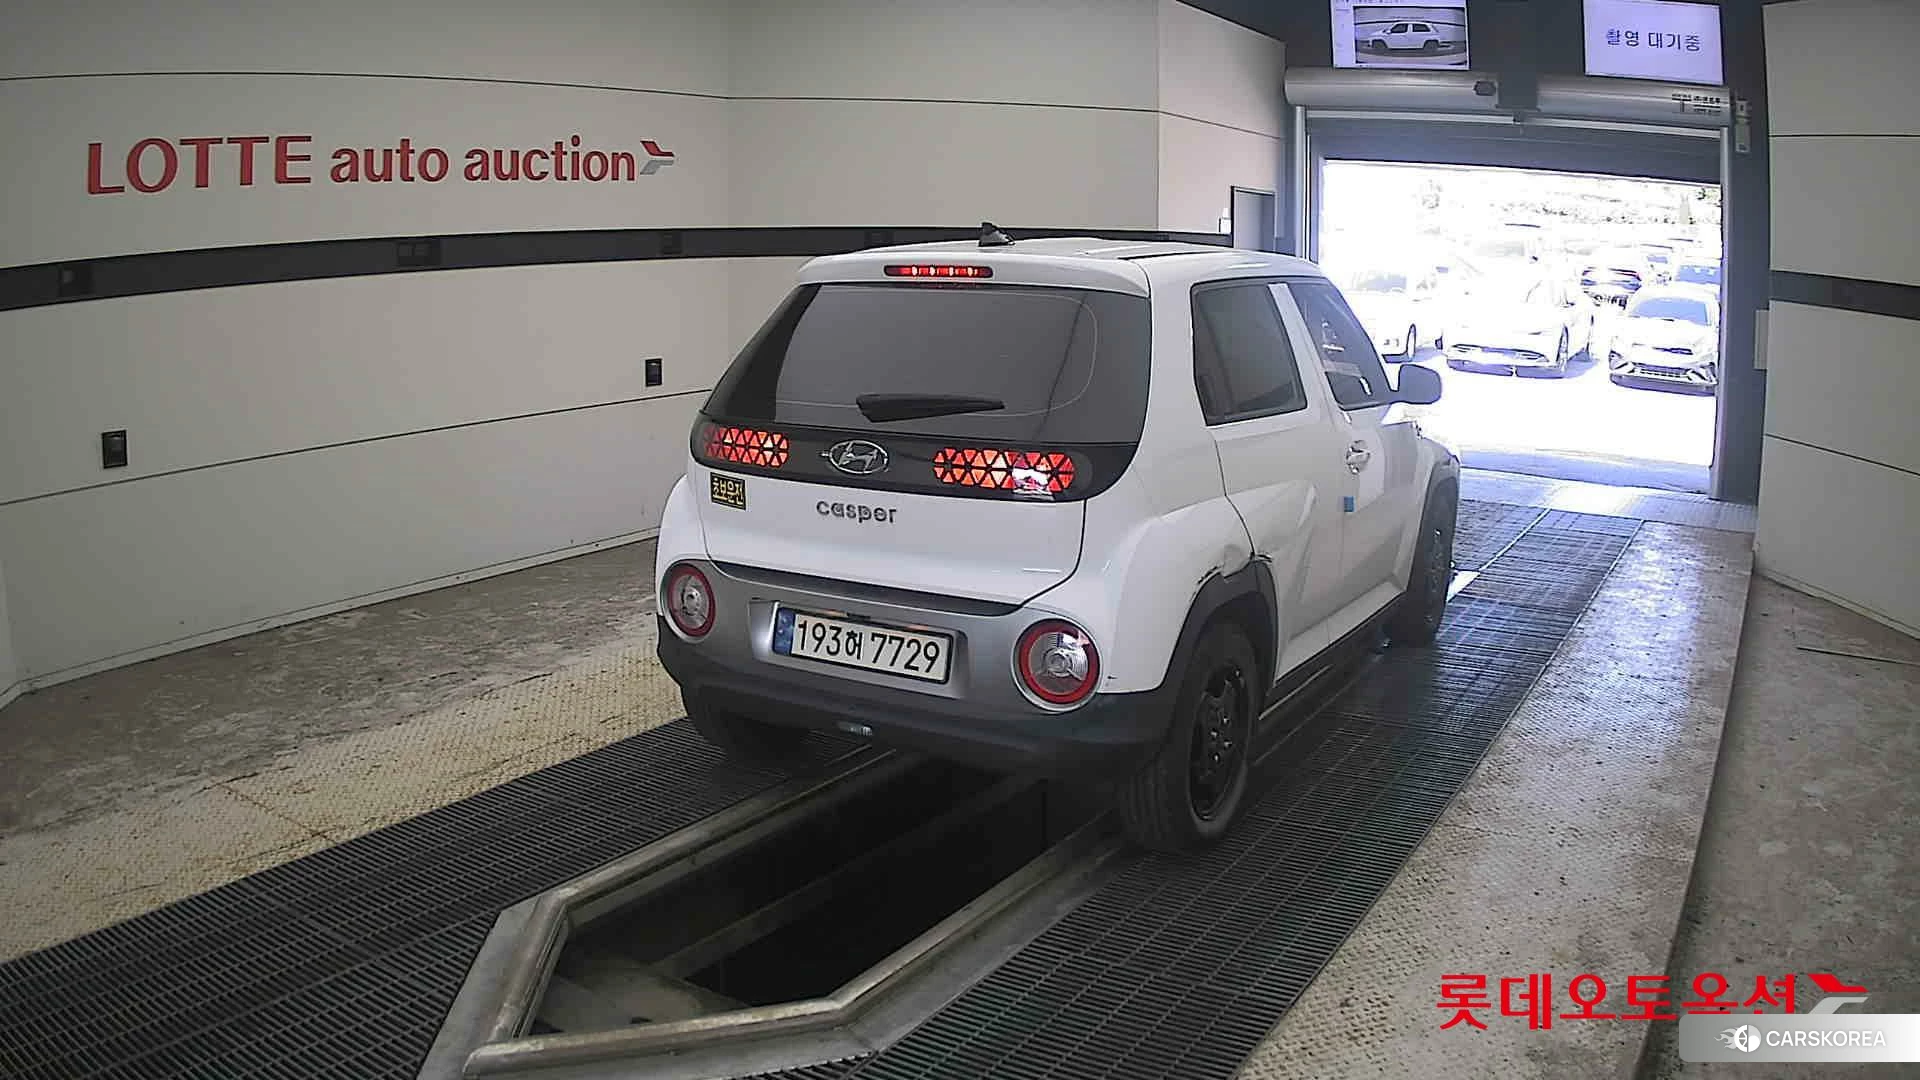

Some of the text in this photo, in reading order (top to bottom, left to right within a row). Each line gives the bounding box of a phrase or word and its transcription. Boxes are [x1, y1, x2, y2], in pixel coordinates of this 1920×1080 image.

[1648, 32, 1701, 52] 대기중
[88, 135, 636, 194] LOTTE auto auction
[712, 477, 744, 505] 초보운전
[816, 500, 897, 523] casper
[871, 633, 940, 673] 7729
